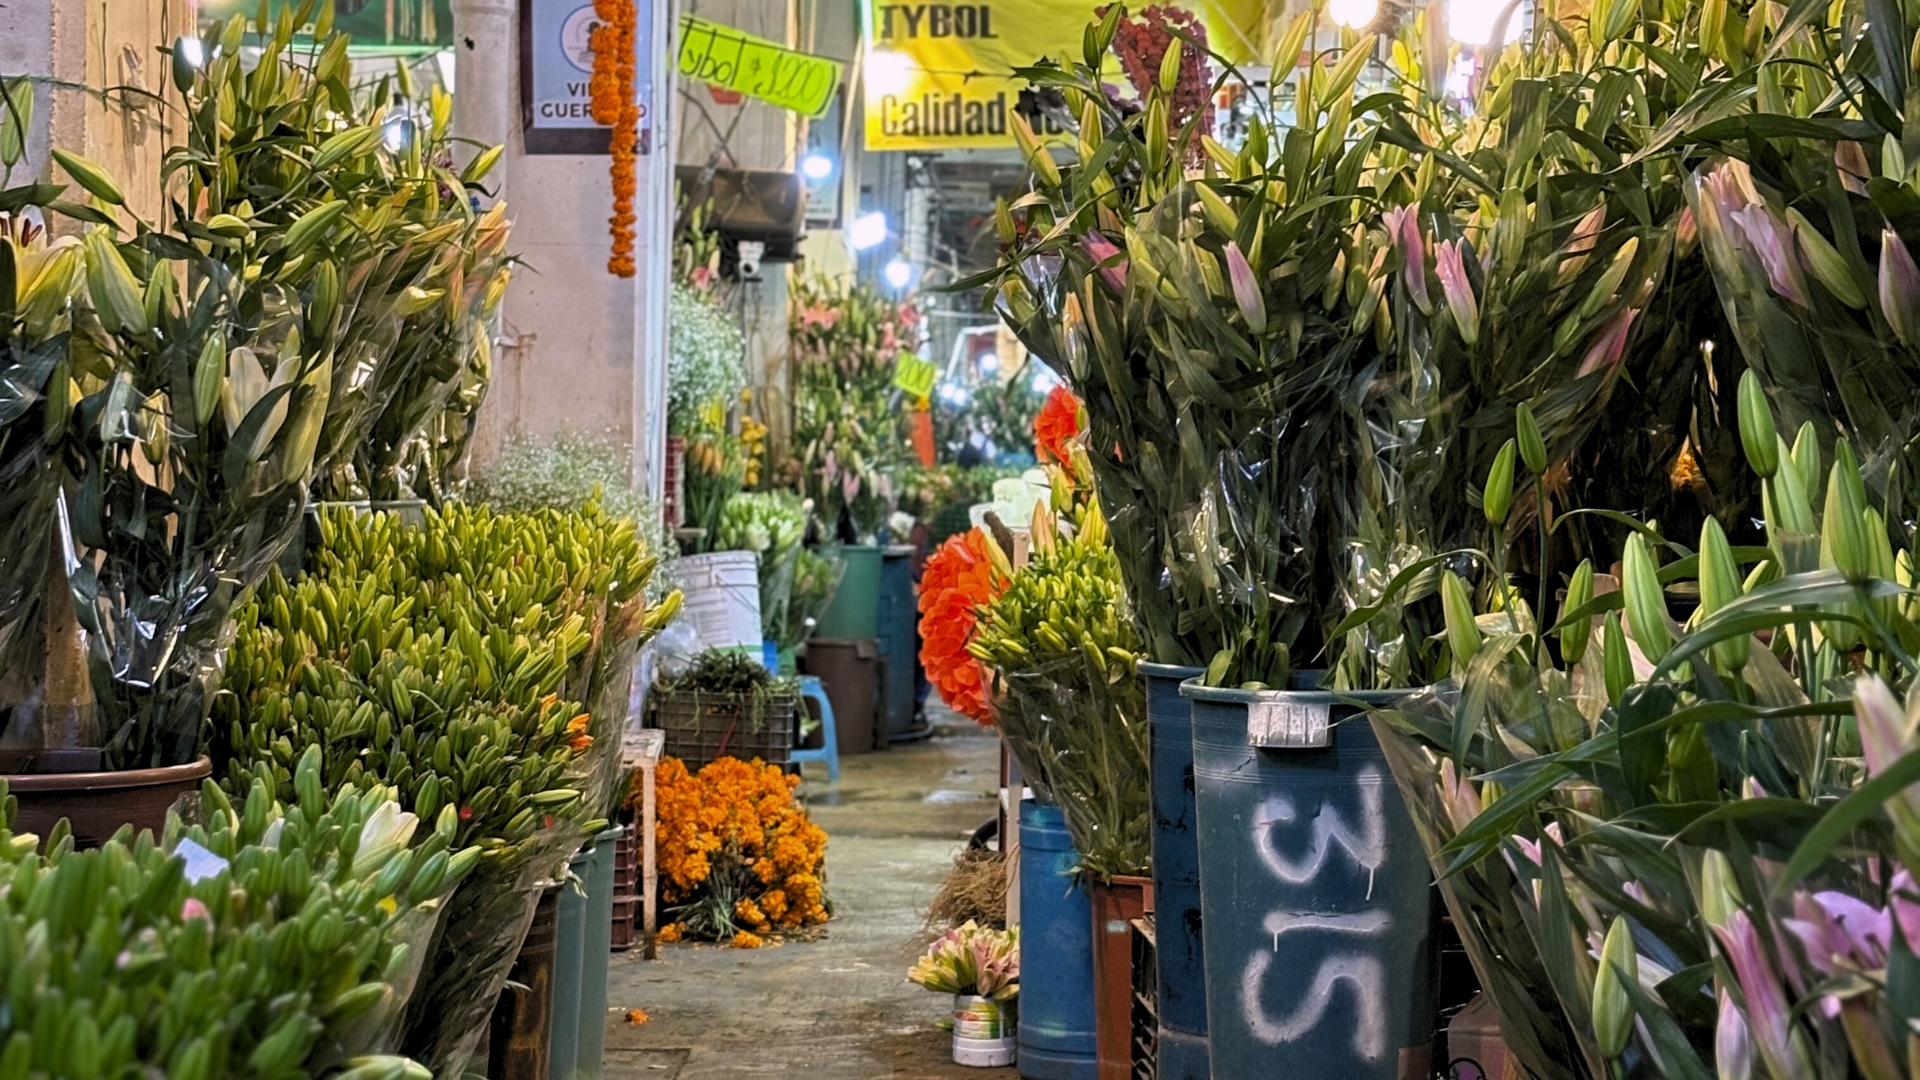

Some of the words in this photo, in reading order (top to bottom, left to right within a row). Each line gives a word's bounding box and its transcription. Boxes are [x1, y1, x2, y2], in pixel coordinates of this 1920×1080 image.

[880, 5, 998, 38] TYBOL
[540, 102, 647, 118] GUERO
[881, 92, 1006, 136] Calidad
